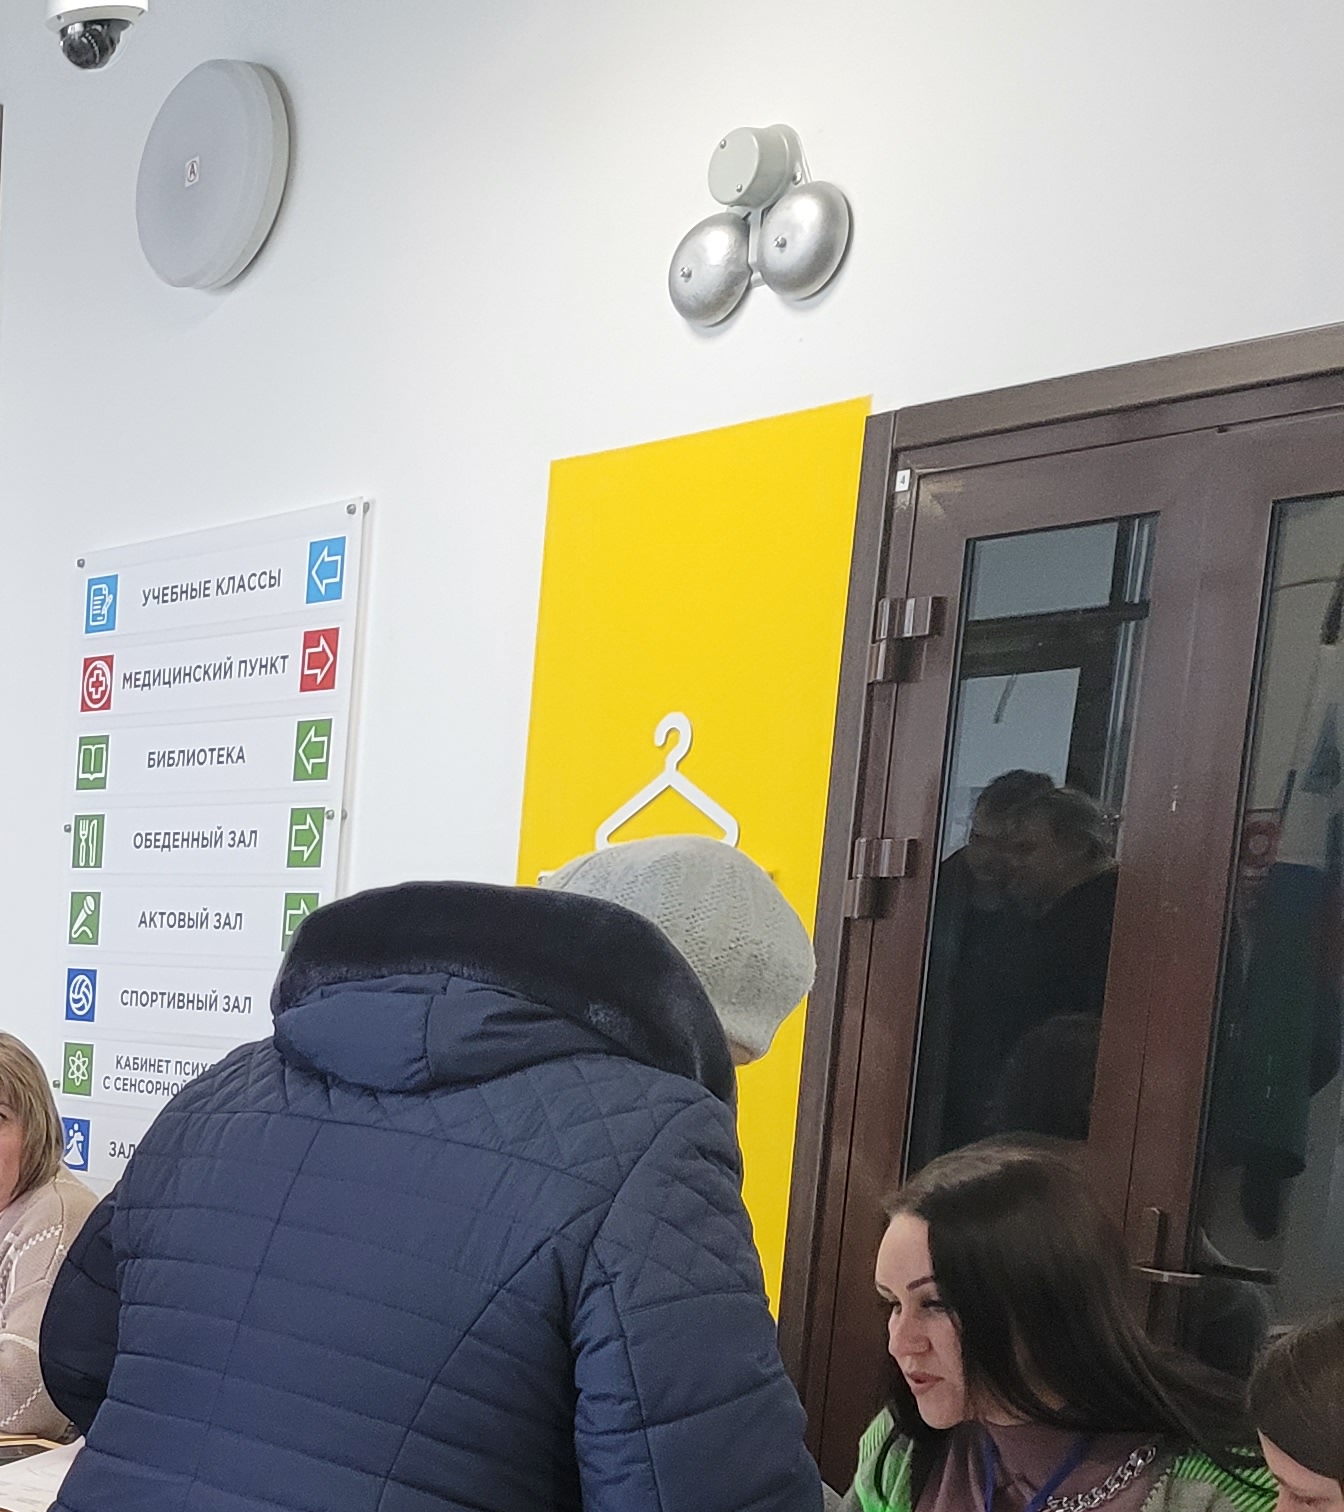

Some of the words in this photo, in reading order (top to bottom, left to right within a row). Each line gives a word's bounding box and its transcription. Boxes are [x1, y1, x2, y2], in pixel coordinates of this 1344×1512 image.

[141, 579, 212, 607] УЧЕБНЫЕ
[215, 568, 282, 597] КЛАССЫ
[122, 656, 233, 692] МЕДИЦИНСКИЙ
[237, 655, 290, 678] ПУНКТ
[146, 745, 246, 769] БИБЛИОТЕКА
[132, 826, 225, 852] ОБЕДЕННЫЙ
[227, 830, 258, 849] ЗАЛ
[137, 907, 209, 930] АКТОВЫЙ
[213, 912, 243, 931] ЗАЛ
[120, 989, 219, 1012] СПОРТИВНЫЙ
[222, 995, 252, 1014] ЗАЛ
[115, 1055, 172, 1075] КАБИНЕТ
[174, 1060, 215, 1078] ПСИХ
[102, 1075, 111, 1090] С
[108, 1141, 136, 1160] ЗАЛ
